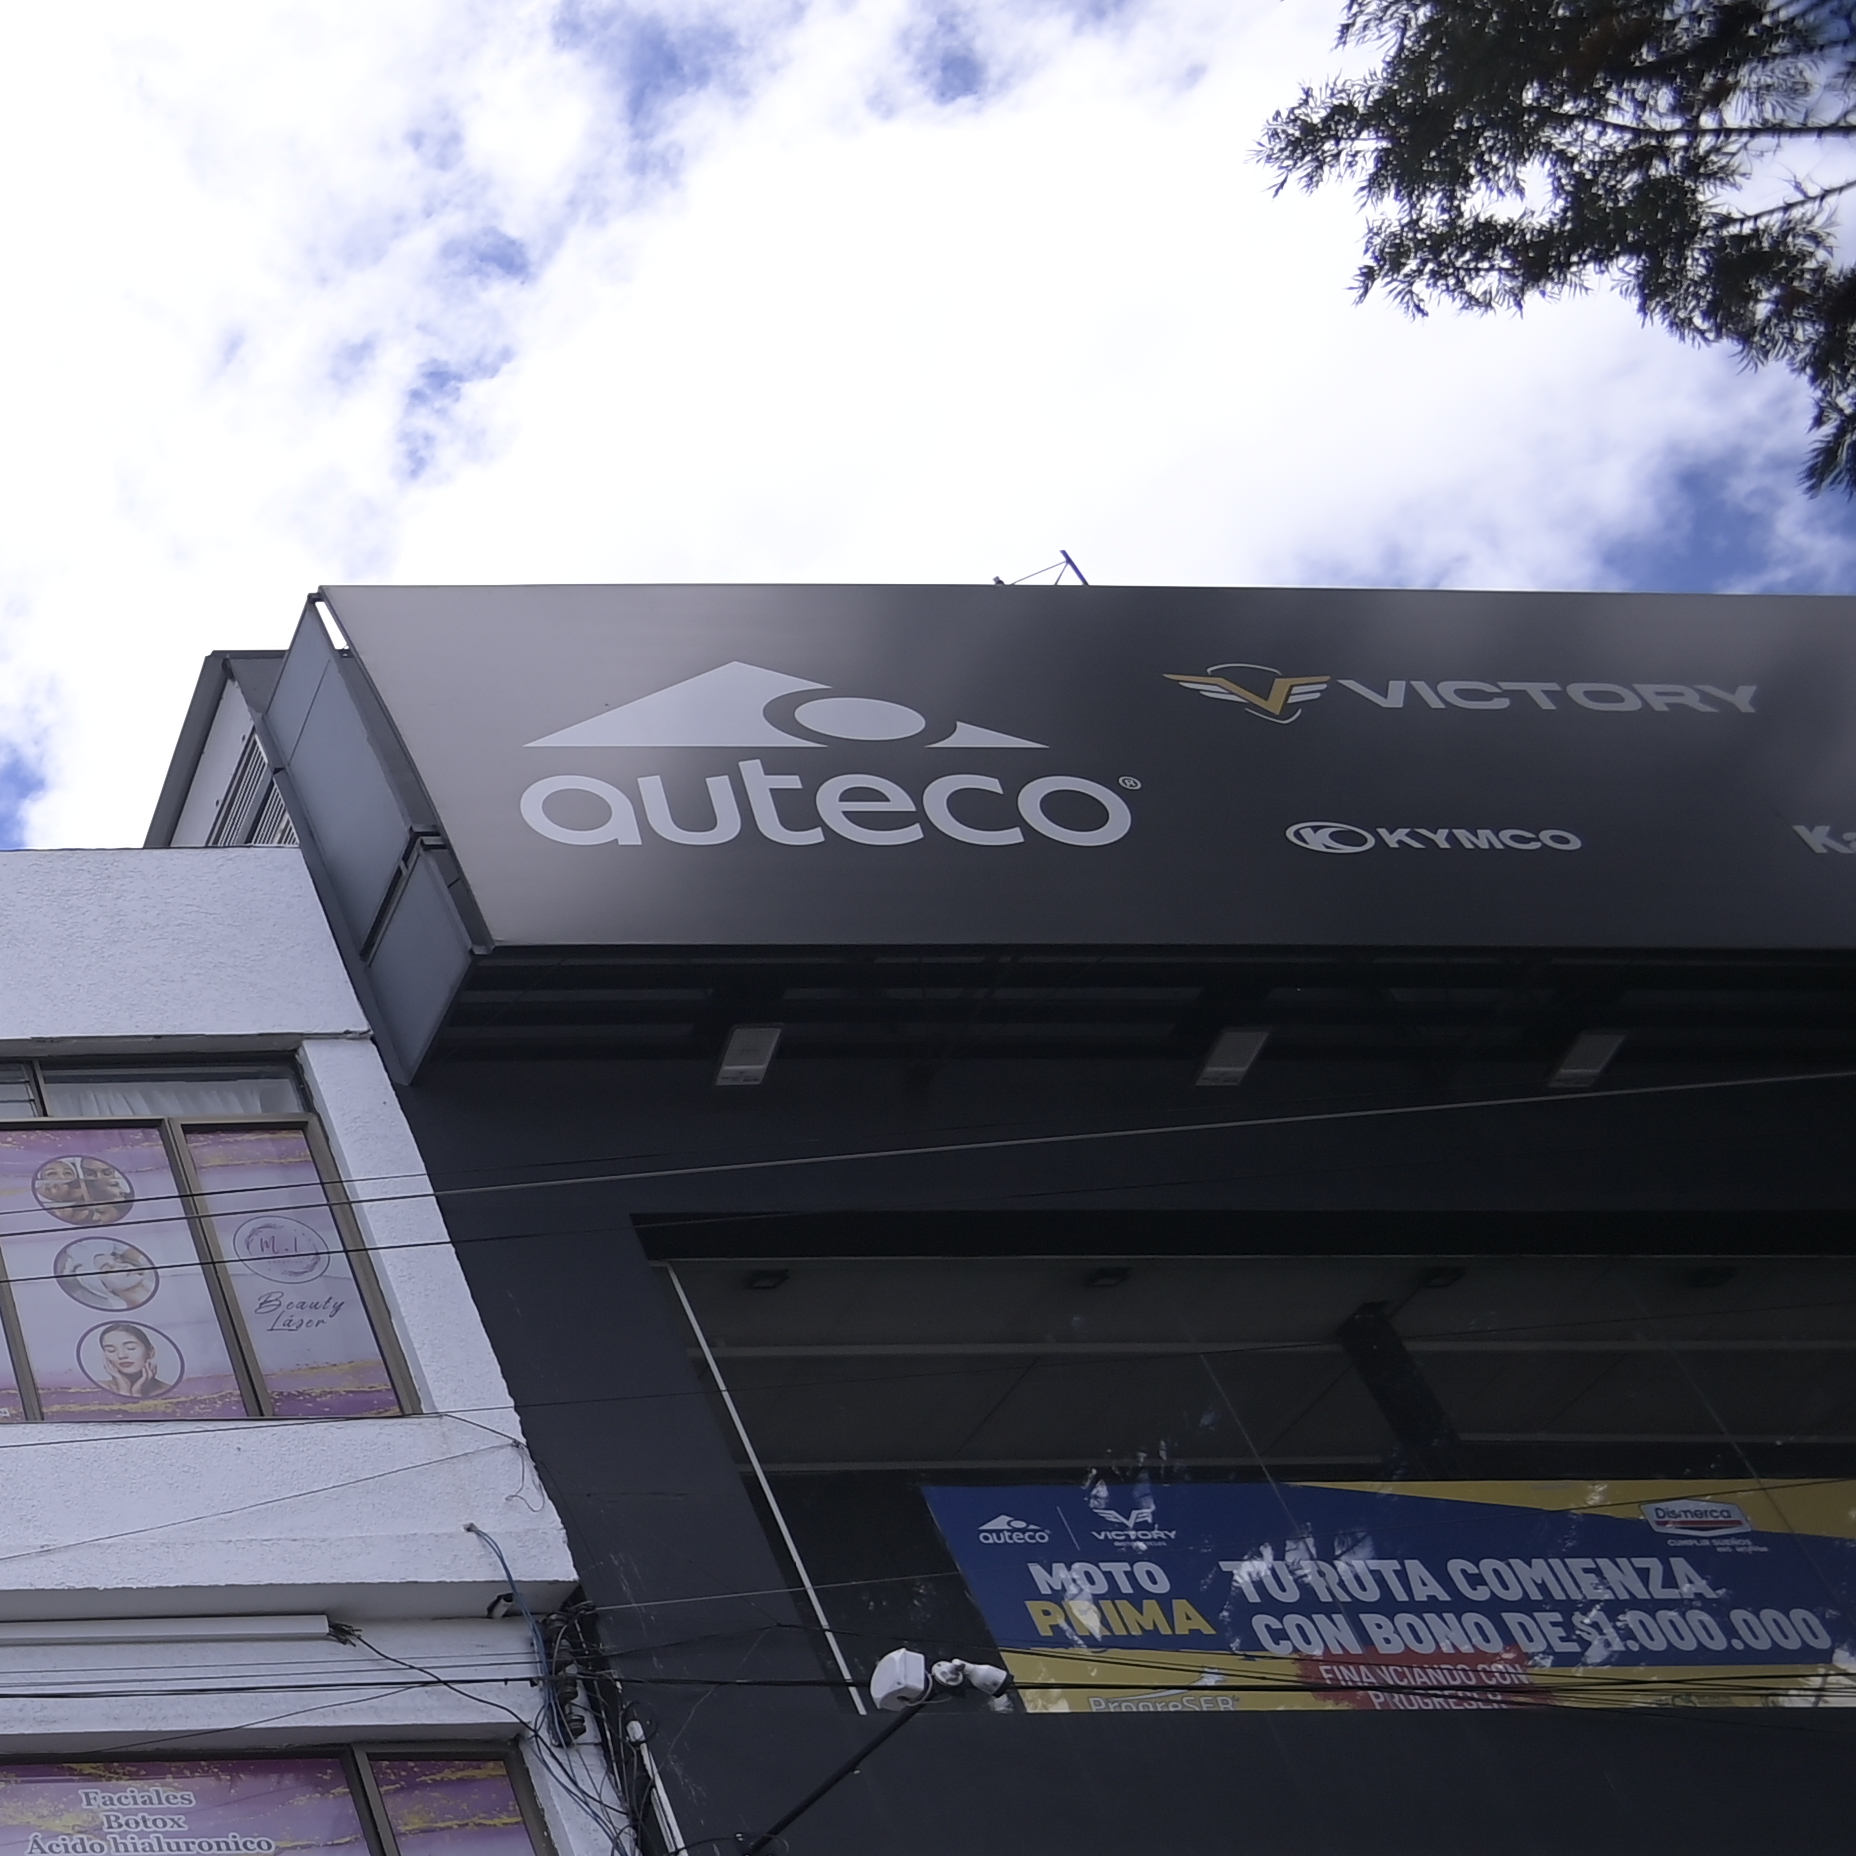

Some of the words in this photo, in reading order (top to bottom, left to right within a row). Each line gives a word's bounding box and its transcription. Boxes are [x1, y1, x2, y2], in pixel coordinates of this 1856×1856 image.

[1337, 679, 1758, 713] VICTORY
[520, 759, 1132, 846] auteco
[1376, 827, 1582, 851] KYMCO
[254, 1290, 345, 1318] Beauty
[1654, 1506, 1732, 1519] Dismerca
[978, 1530, 1049, 1544] auteco
[1091, 1530, 1177, 1541] VICTORY
[1027, 1561, 1171, 1595] MOTO
[1218, 1560, 1304, 1603] TU
[1309, 1558, 1452, 1602] RUTA
[1446, 1556, 1718, 1602] COMIENZA
[1025, 1600, 1217, 1637] PRIMA
[1250, 1613, 1363, 1656] CON
[1359, 1611, 1505, 1655] BONO
[1502, 1611, 1579, 1653] DE
[1482, 1663, 1531, 1685] CON
[81, 1788, 194, 1808] Faciales
[103, 1812, 186, 1832] Botox
[25, 1833, 106, 1856] Ácido
[110, 1833, 273, 1854] hialuronico
